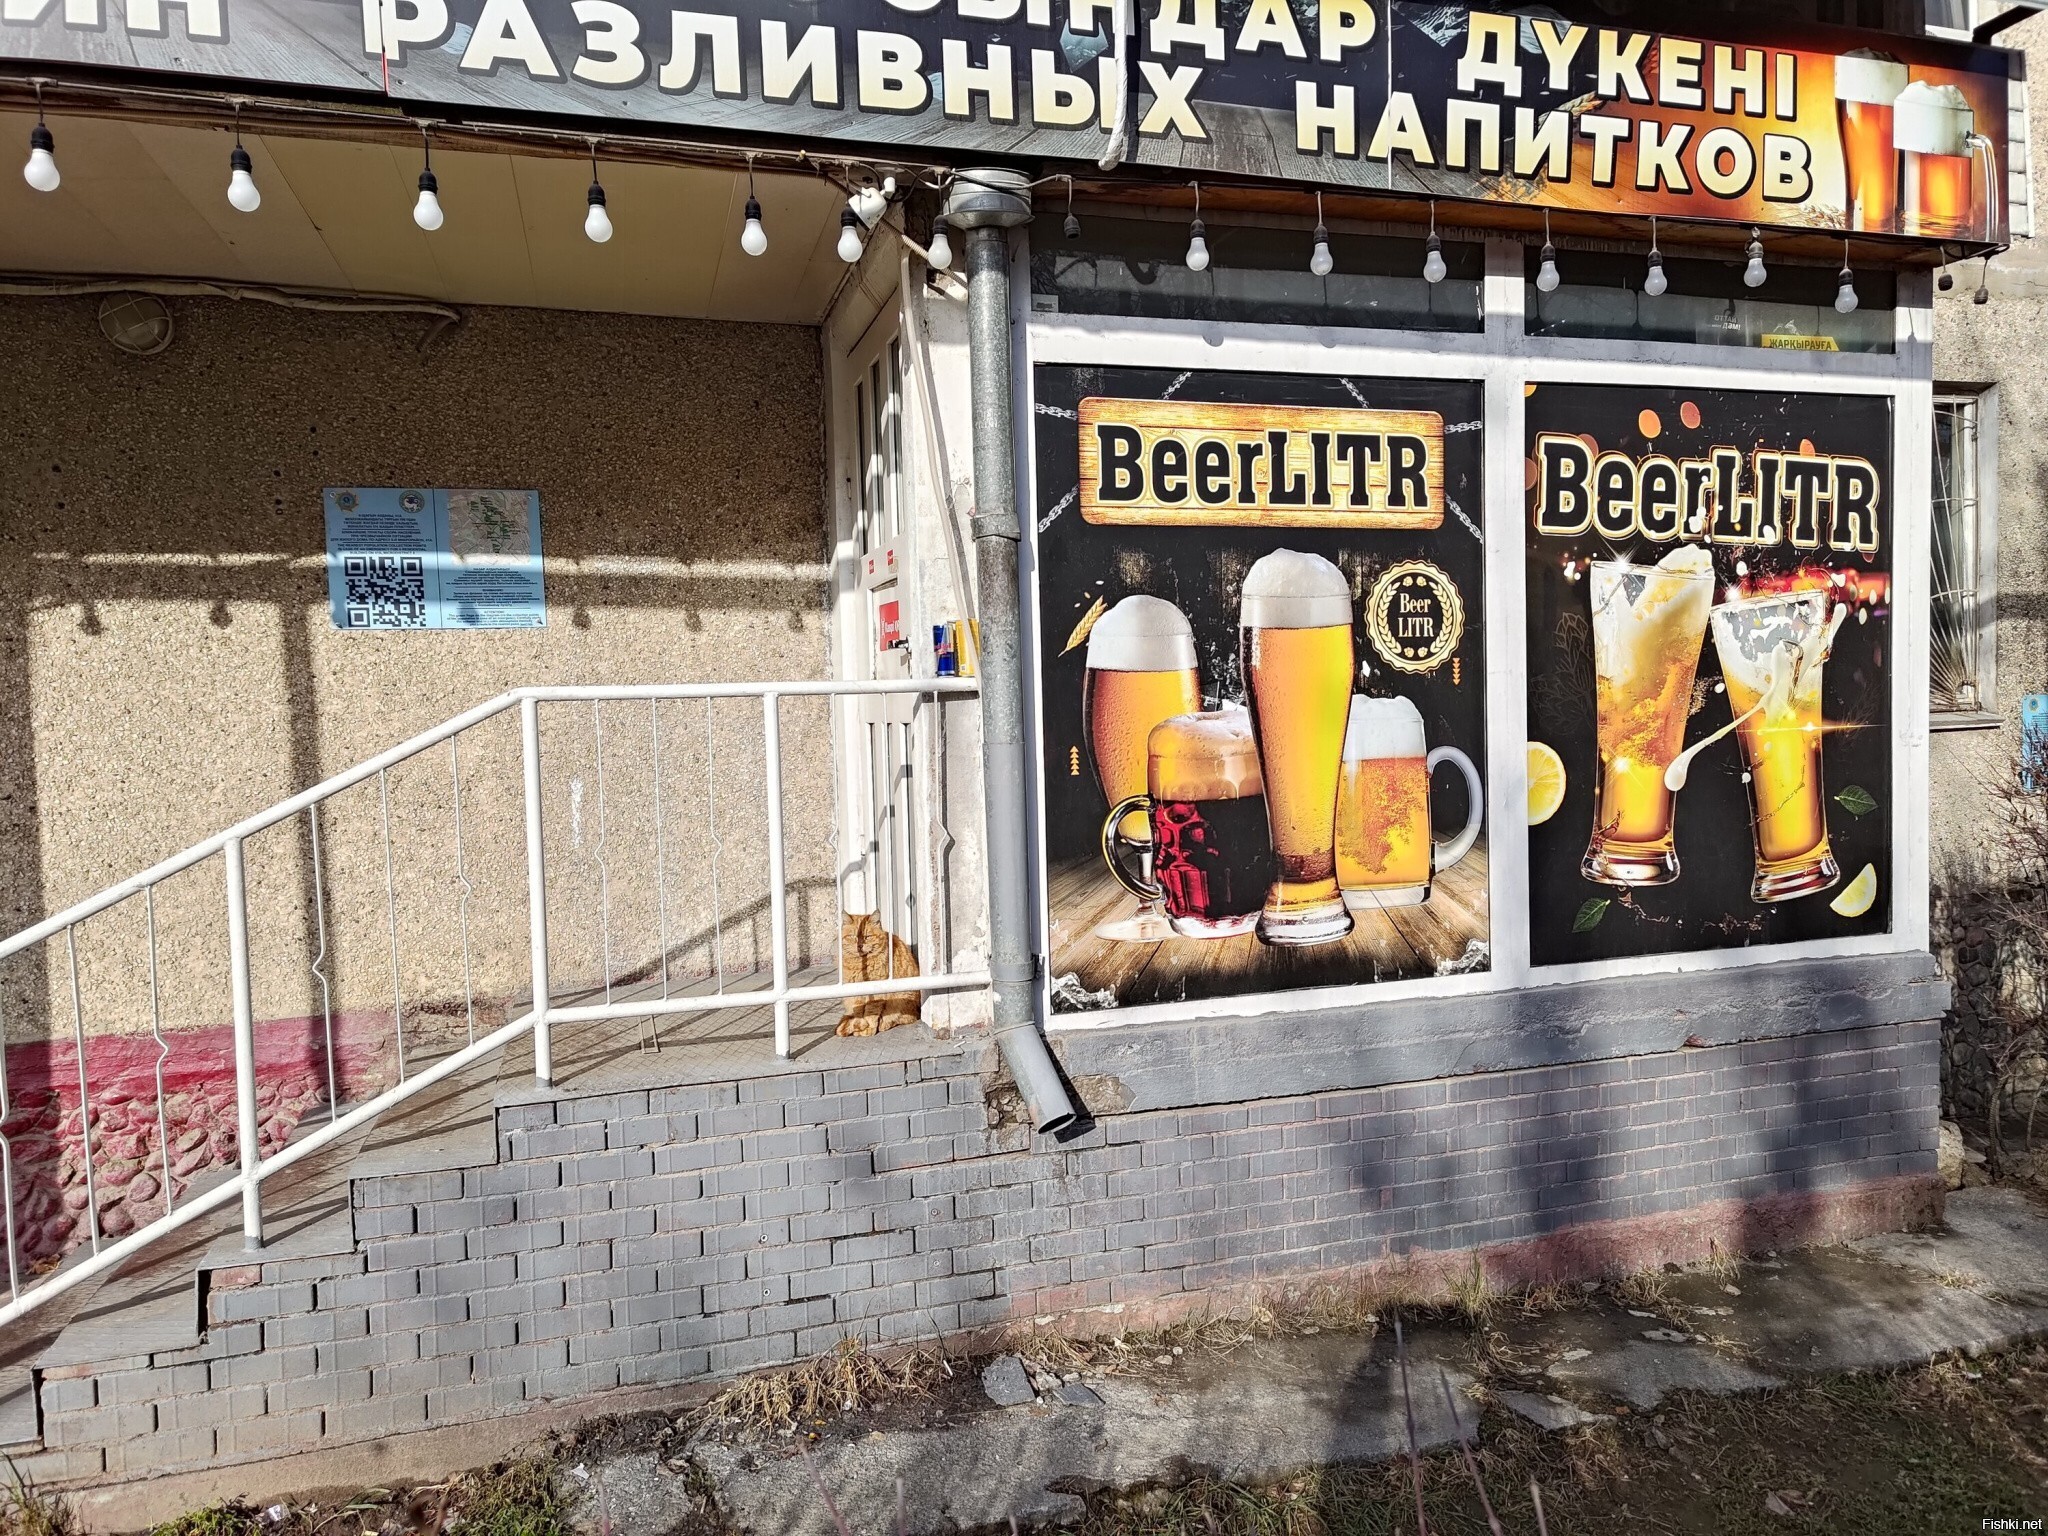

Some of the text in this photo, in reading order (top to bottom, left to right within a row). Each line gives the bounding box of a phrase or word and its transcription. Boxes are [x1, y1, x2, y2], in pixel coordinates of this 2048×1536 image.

[363, 0, 1811, 200] РАЗЛИВНЫХ НАПИТКОВ
[1457, 11, 1797, 120] ДҮКЕНІ
[1769, 338, 1832, 350] ЖАРҚЫРАУҒА
[1096, 422, 1430, 508] BeerLITR
[1538, 437, 1880, 552] BeerLITR
[1398, 617, 1435, 638] LITR
[1400, 592, 1432, 613] Beer
